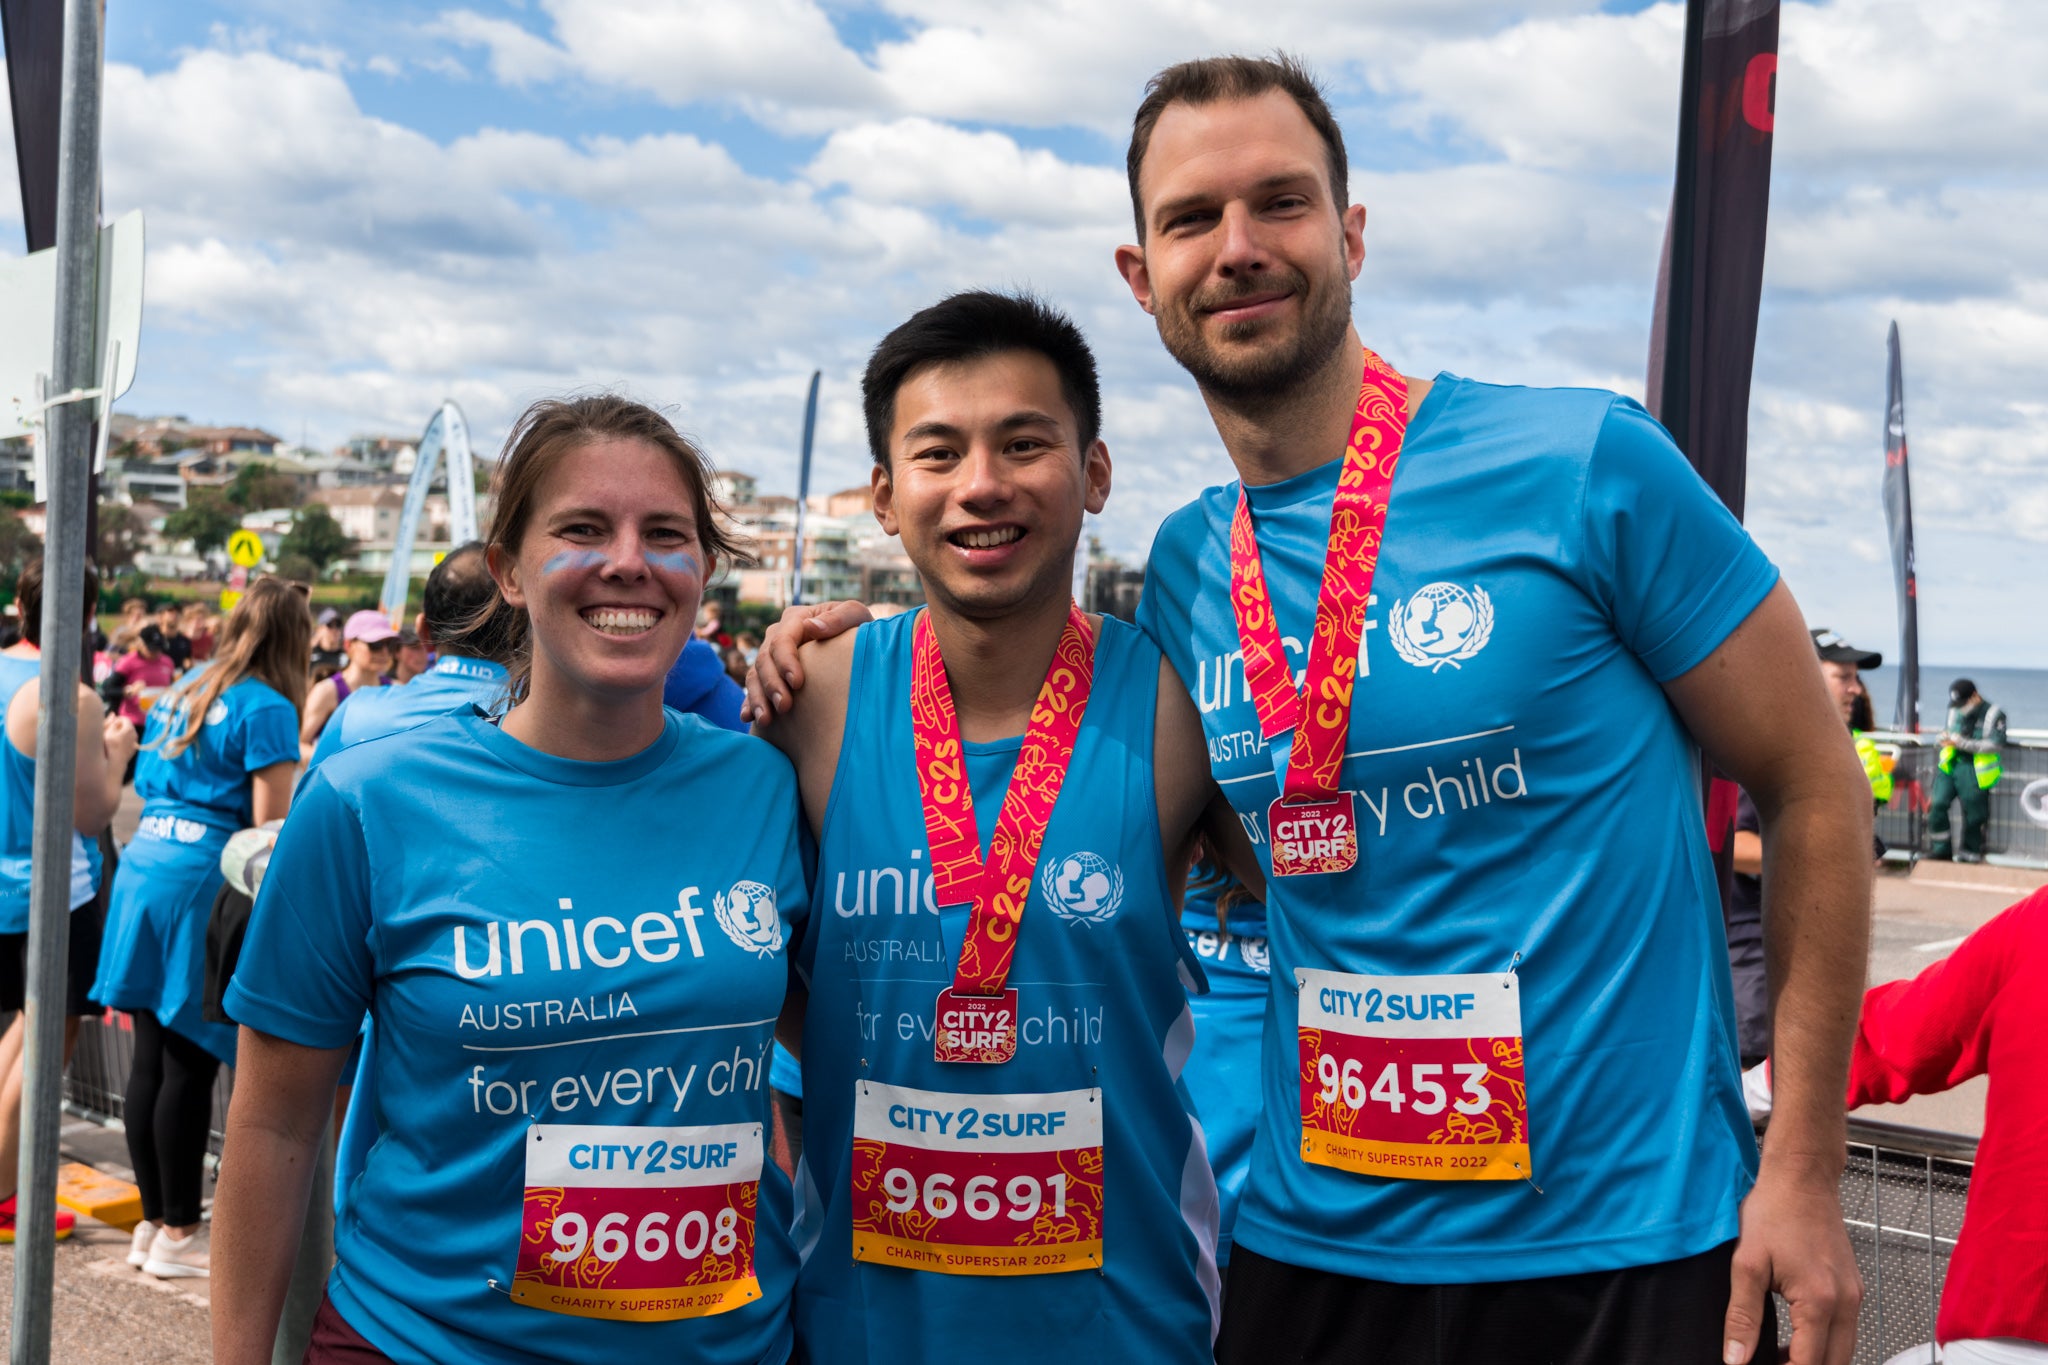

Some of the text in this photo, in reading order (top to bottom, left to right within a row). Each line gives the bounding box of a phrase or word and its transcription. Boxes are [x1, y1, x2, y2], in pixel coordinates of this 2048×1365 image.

[1238, 811, 1266, 845] or
[1403, 748, 1528, 820] child
[1276, 814, 1348, 840] CITY2
[1301, 810, 1321, 819] 2022
[1283, 838, 1346, 861] SURF
[835, 849, 939, 918] unic
[453, 886, 705, 979] unicef
[844, 940, 946, 962] AUSTRALI
[459, 992, 638, 1031] AUSTRALIA
[943, 1010, 1011, 1031] CITY2
[1319, 987, 1475, 1023] CITY2SURF
[856, 1001, 881, 1041] for
[1022, 1006, 1104, 1045] child
[946, 1030, 1007, 1049] SURF
[468, 1038, 771, 1115] for every chi
[1317, 1053, 1491, 1115] 96453
[888, 1104, 1066, 1139] CITY2SURF
[568, 1140, 738, 1174] CITY2SURF
[1326, 1143, 1488, 1168] CHARITY SUPERSTAR 2022
[883, 1167, 1066, 1221] 96691
[550, 1207, 738, 1262] 96608
[886, 1246, 1066, 1267] CHARITY SUPERSTAR 2022
[551, 1292, 725, 1311] CHARITY SUPERSTAR 2022
